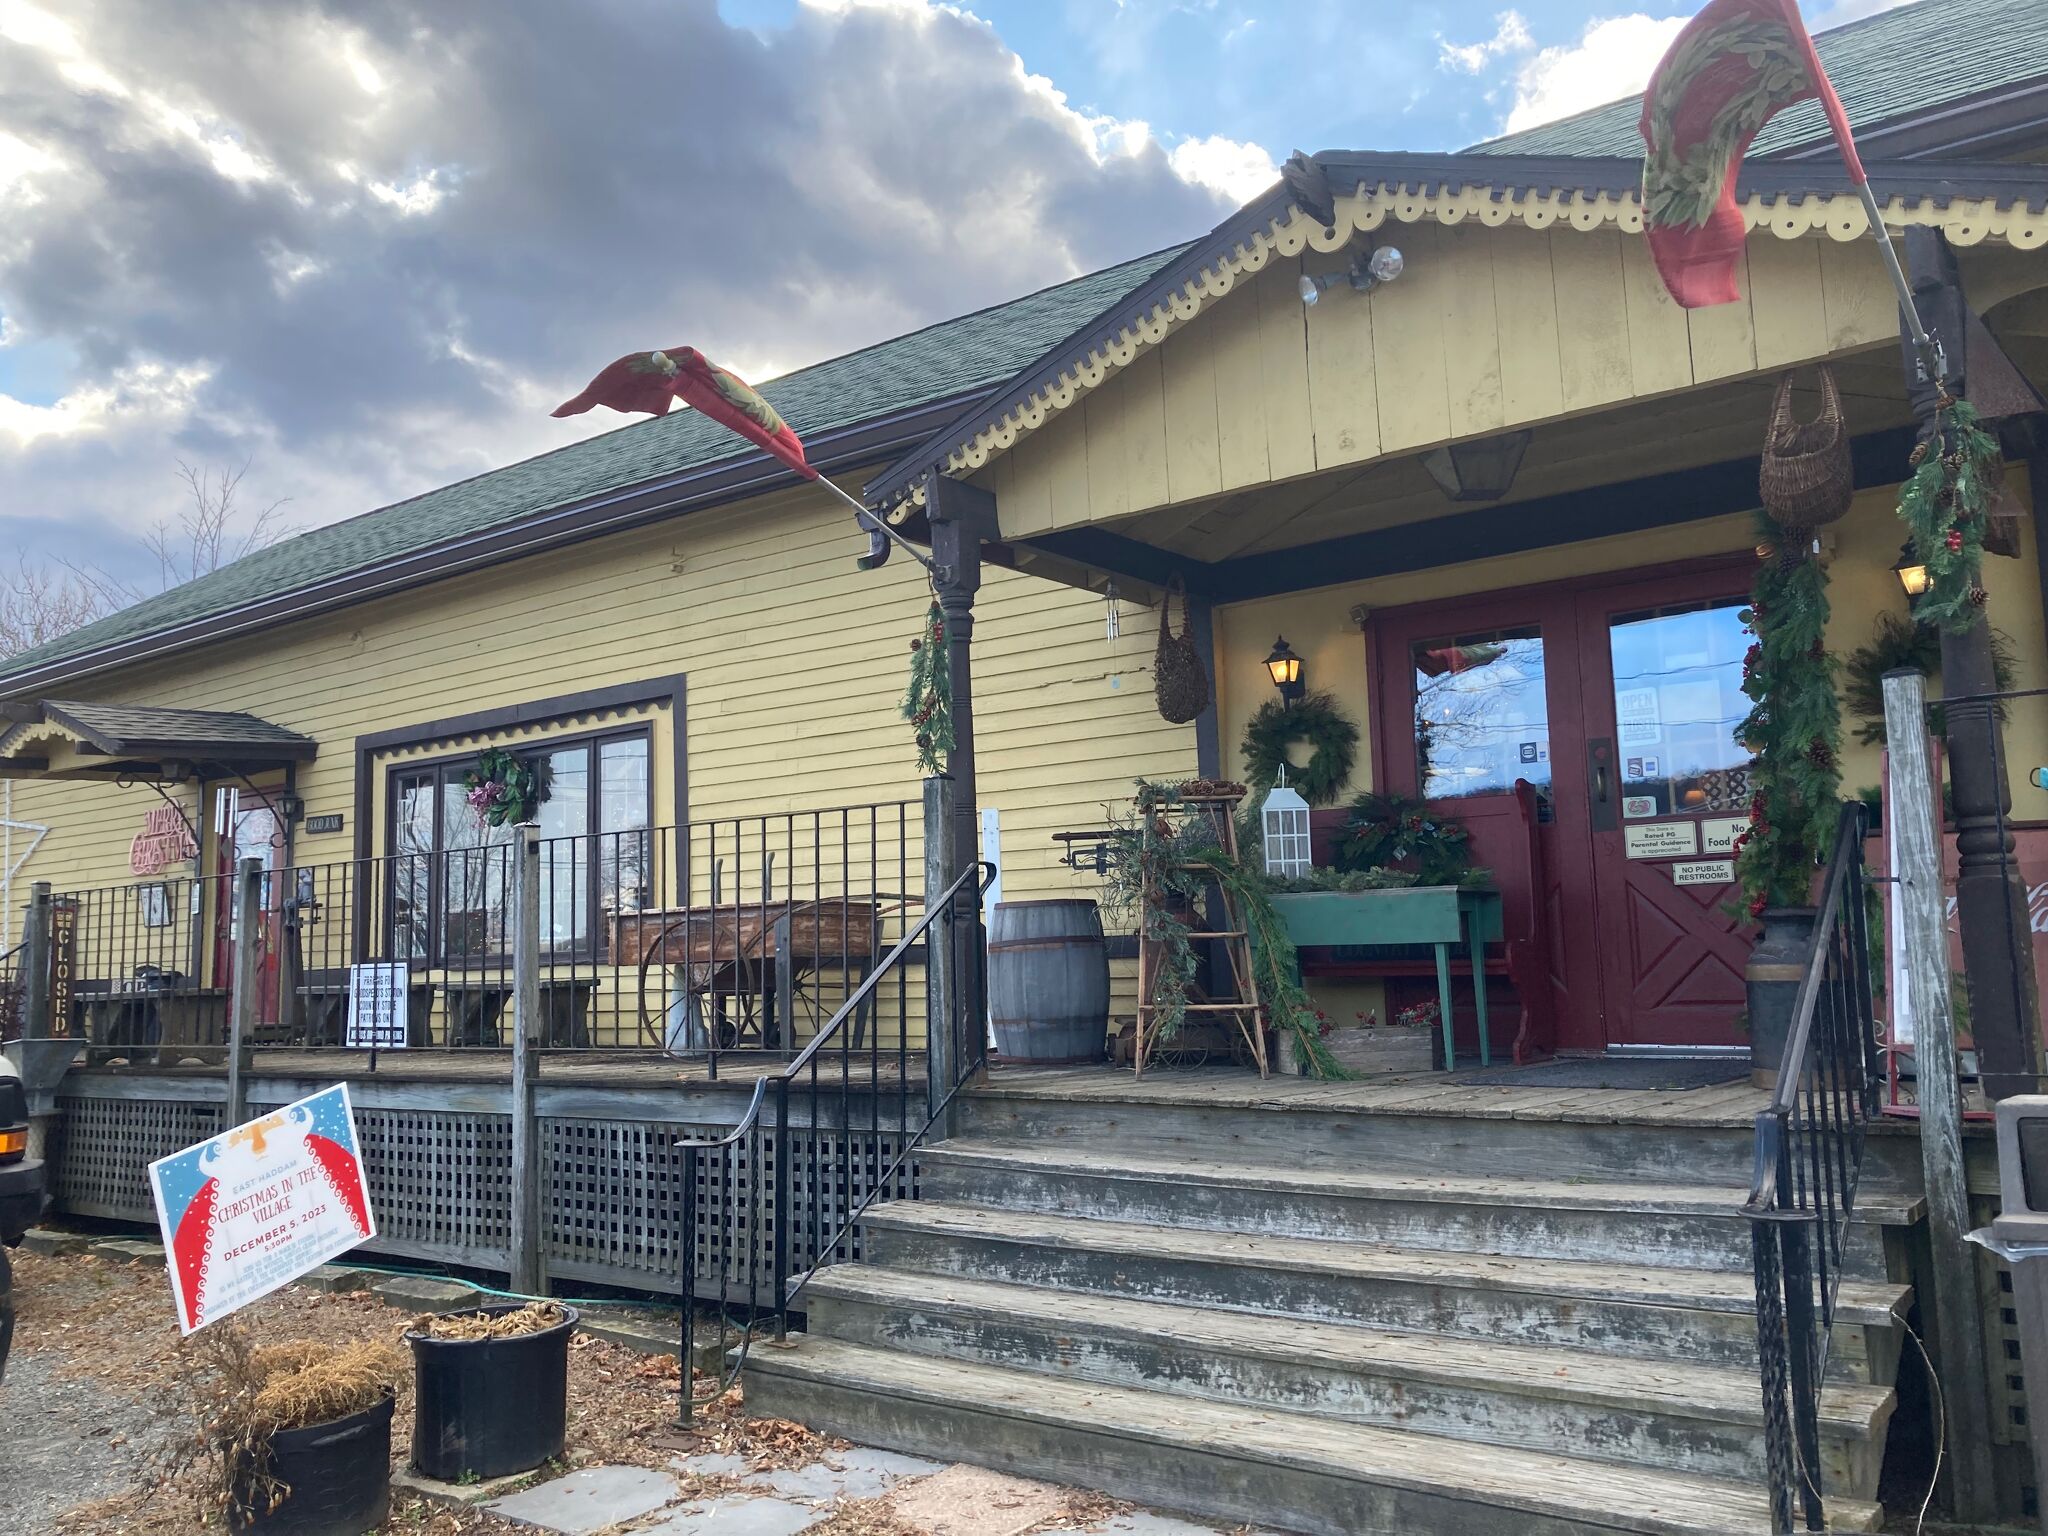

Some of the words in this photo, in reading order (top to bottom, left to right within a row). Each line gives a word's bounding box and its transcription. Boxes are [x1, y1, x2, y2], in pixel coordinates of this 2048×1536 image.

[1732, 824, 1745, 833] No
[1708, 837, 1730, 846] Food
[1679, 872, 1729, 881] RESTROOMS
[364, 975, 384, 985] PARNG
[354, 988, 384, 998] GODSPED'S
[385, 988, 402, 998] STTION
[359, 1000, 380, 1010] COUNTY
[382, 1000, 396, 1010] STOE
[360, 1013, 381, 1023] PATRNS
[385, 1030, 402, 1040] PAKING
[232, 1178, 256, 1195] EAST
[258, 1160, 298, 1182] HADDAM
[218, 1184, 278, 1224] CHRISTMAS
[281, 1177, 293, 1194] IN
[296, 1166, 318, 1186] THE
[252, 1195, 293, 1224] VILLAGE
[224, 1224, 289, 1261] DECEMBER
[290, 1220, 299, 1228] 5,
[301, 1204, 326, 1223] 2023
[264, 1234, 293, 1252] 5:30PM
